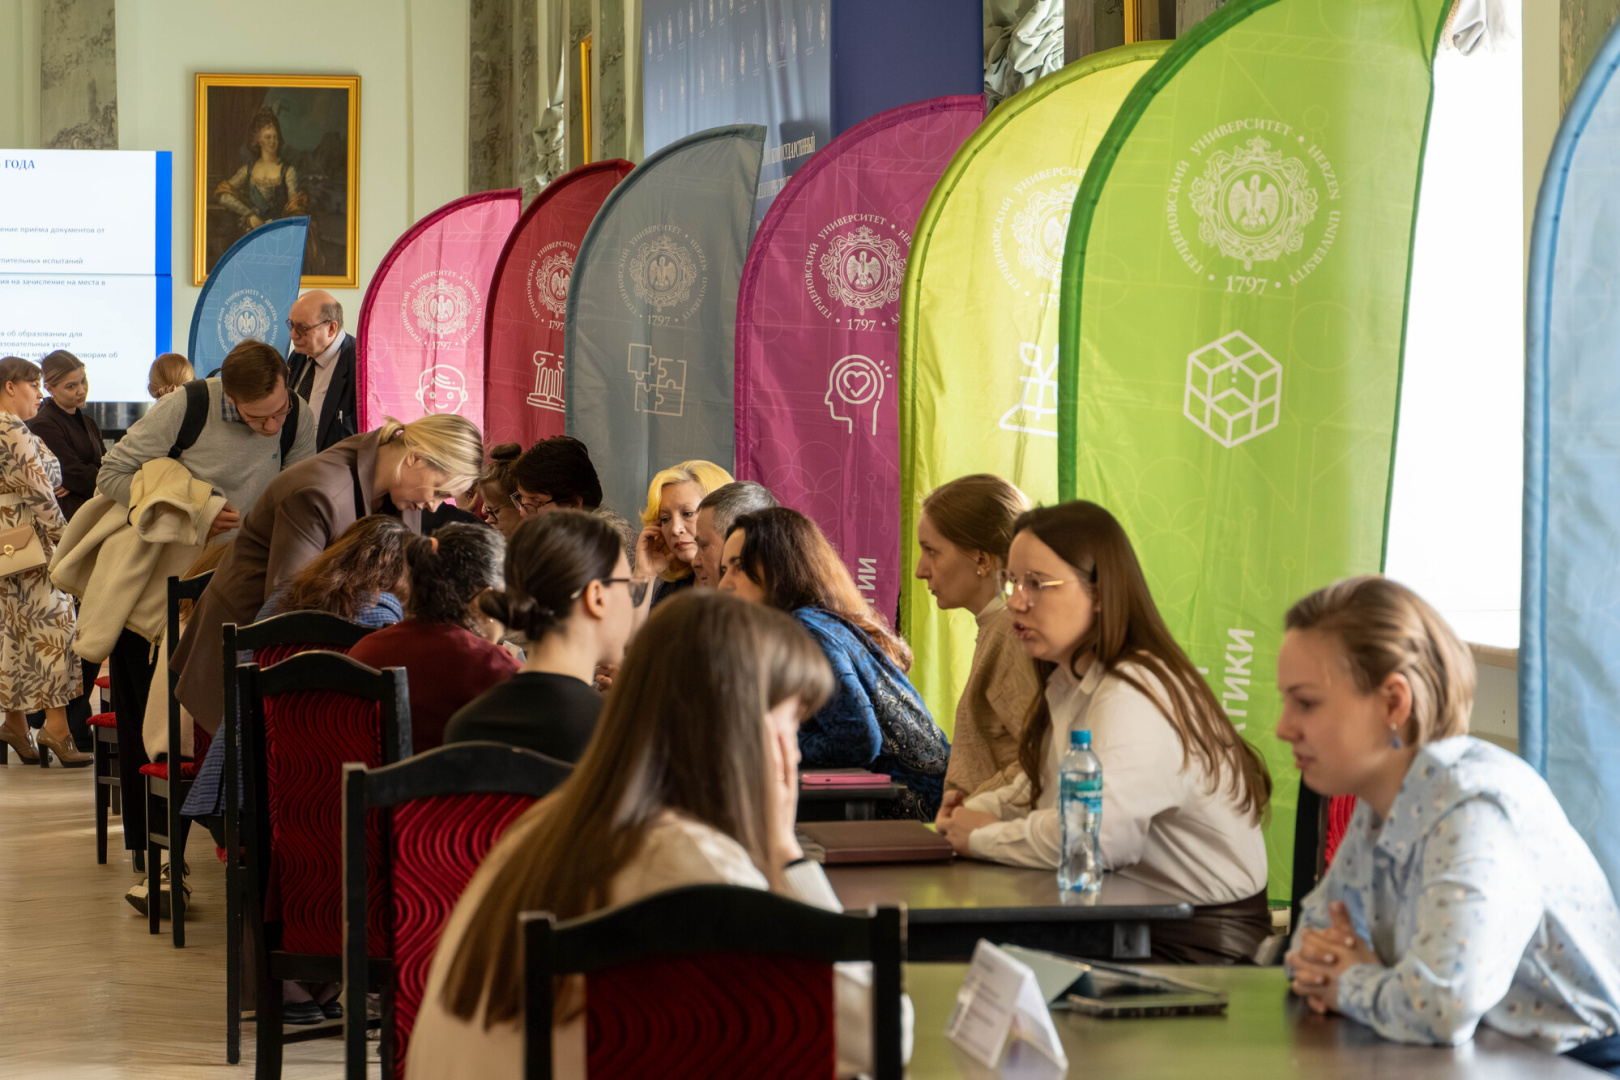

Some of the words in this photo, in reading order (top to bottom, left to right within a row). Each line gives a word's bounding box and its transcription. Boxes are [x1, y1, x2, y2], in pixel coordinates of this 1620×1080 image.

[4, 159, 35, 170] ГОДА
[1306, 144, 1340, 200] HERZEN
[1013, 166, 1086, 194] УНИВЕРСИТ
[1166, 160, 1204, 275] ГЕРЦЕНОВСКИЙ
[1190, 118, 1292, 156] УНИВЕРСИТЕТ
[817, 213, 887, 240] УНИВЕРСИТЕТ
[1288, 210, 1341, 286] UNIVERSITY
[804, 242, 832, 319] ГЕРЦЕНОВСКИЙ
[1225, 275, 1268, 295] 1797
[1038, 292, 1060, 308] 179
[548, 319, 564, 331] 1797
[647, 315, 671, 327] 1797
[847, 318, 876, 332] 1797
[432, 340, 452, 350] 1797
